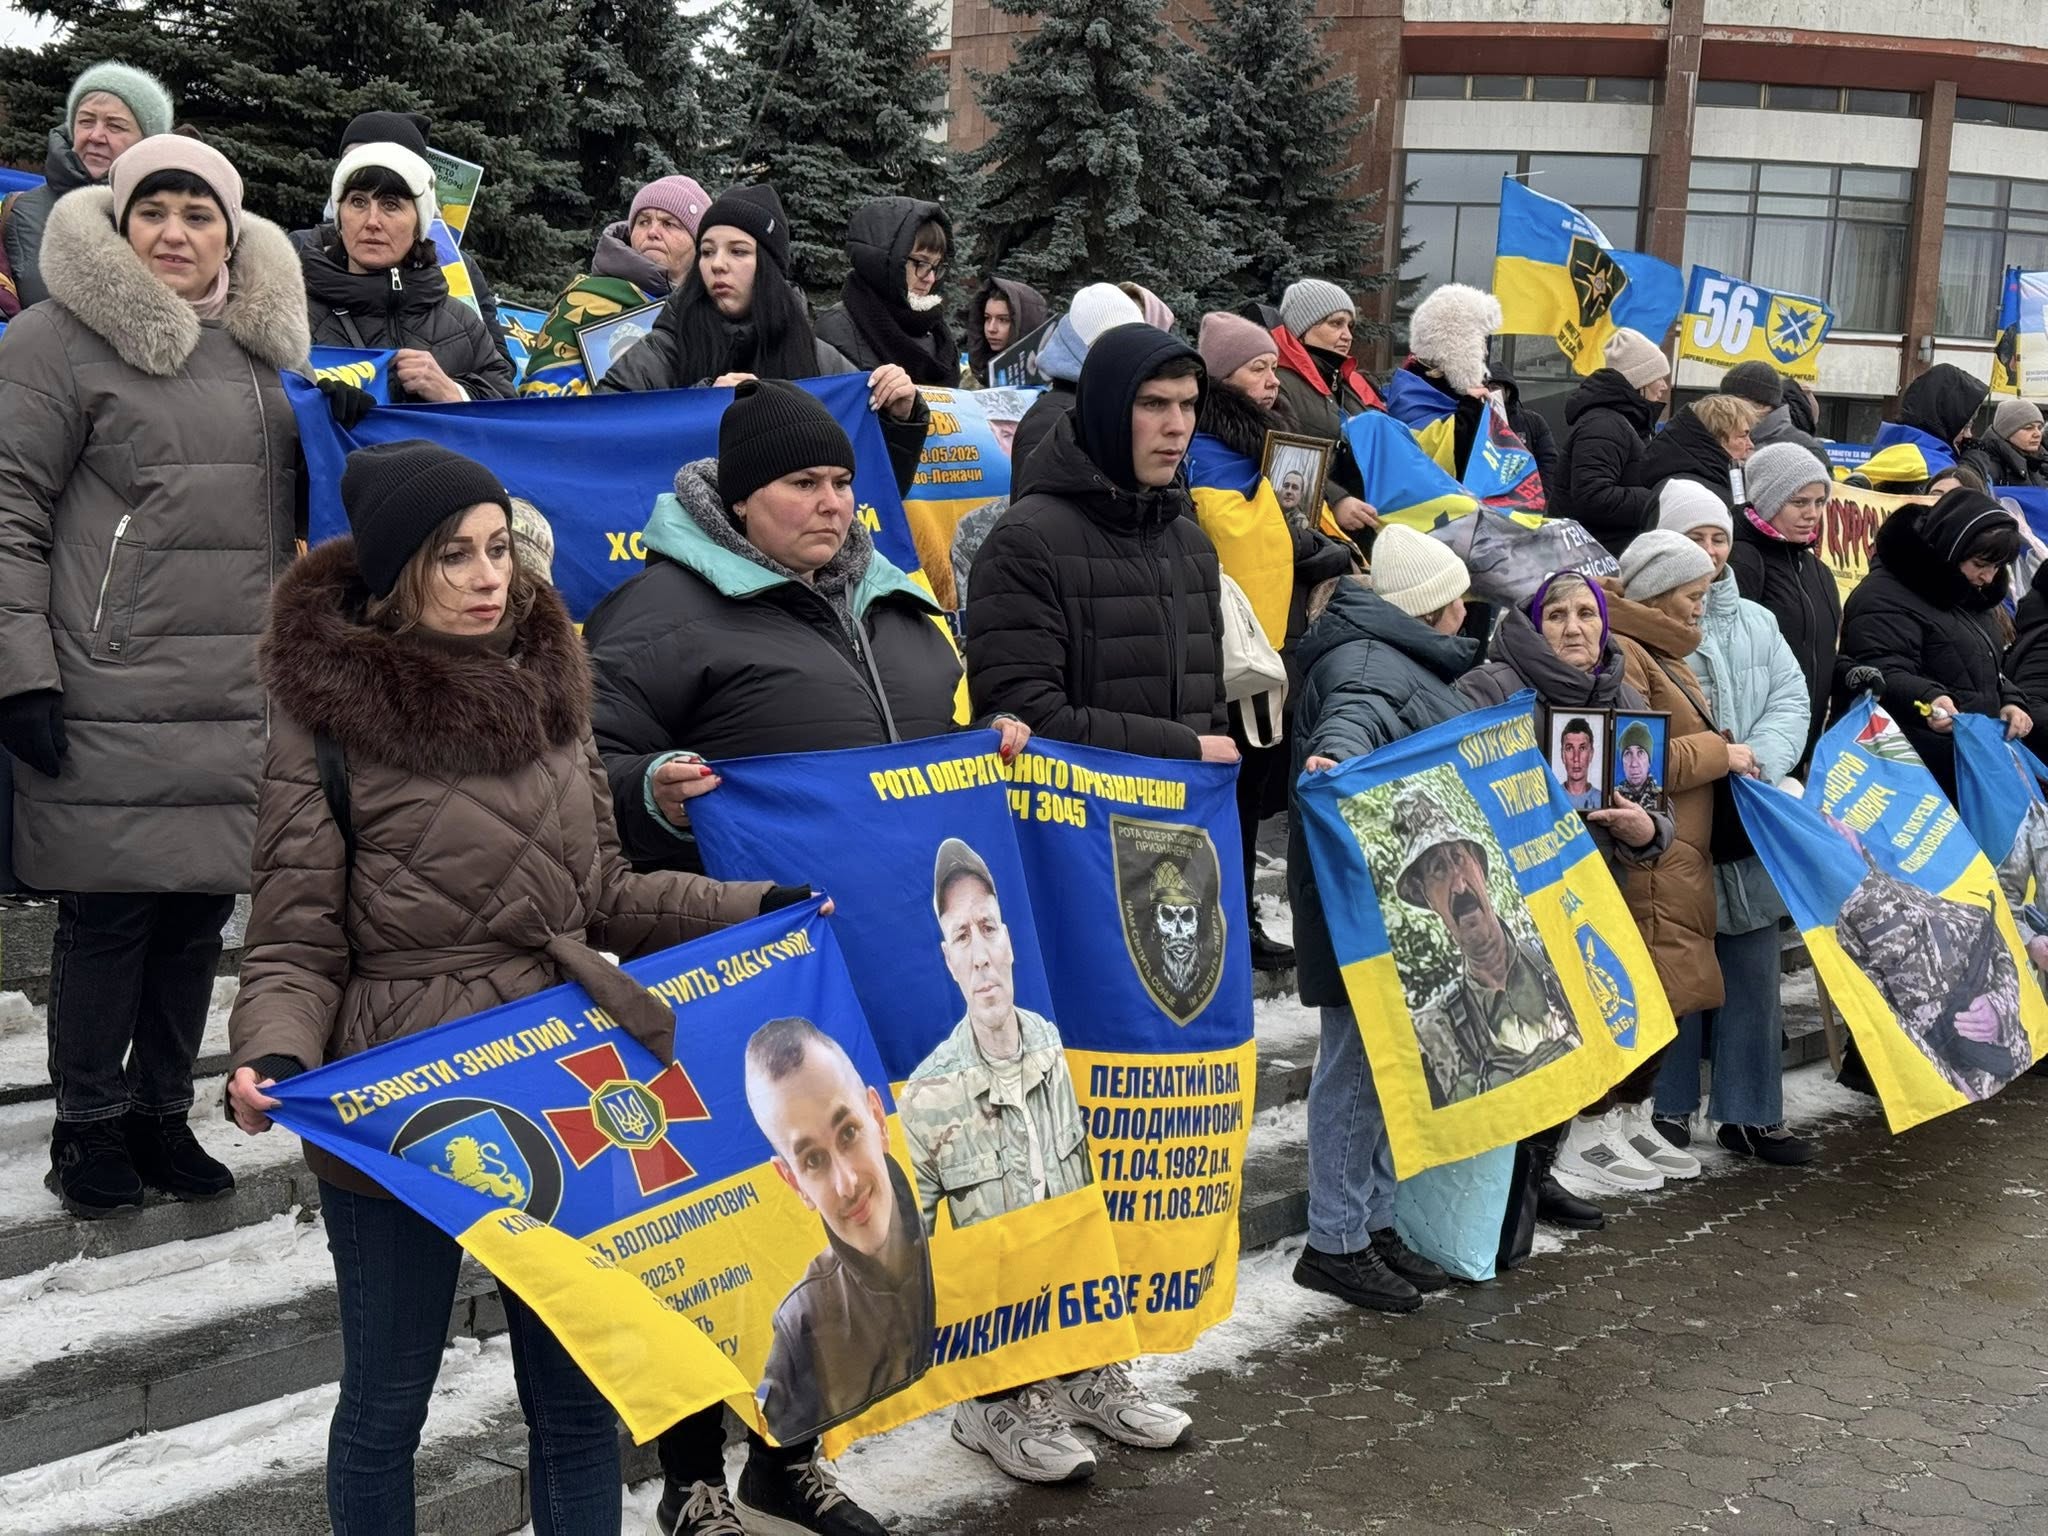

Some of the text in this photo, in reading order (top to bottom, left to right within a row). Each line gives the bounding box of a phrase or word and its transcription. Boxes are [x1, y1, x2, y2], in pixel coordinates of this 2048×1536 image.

[1693, 277, 1759, 355] 56
[870, 765, 931, 801] РОТА
[1071, 763, 1186, 811] ПРИЗНАЧЕННЯ
[1036, 791, 1087, 828] 3045
[330, 1060, 461, 1125] БЕЗВІСТИ
[453, 1017, 577, 1076] ЗНИКЛИЙ
[717, 928, 816, 988] ЗАБУТИЙ!
[1090, 1058, 1241, 1099] ПЕЛЕХАТИЙ ІВАН
[1098, 1145, 1208, 1182] 11.04.1982
[612, 1182, 760, 1260] ВОЛОДИМИРОВИЧ
[1103, 1190, 1138, 1222] ИК
[1143, 1181, 1230, 1222] 11.08.2025
[660, 1262, 754, 1314] СЬКИЙ РАЙОН
